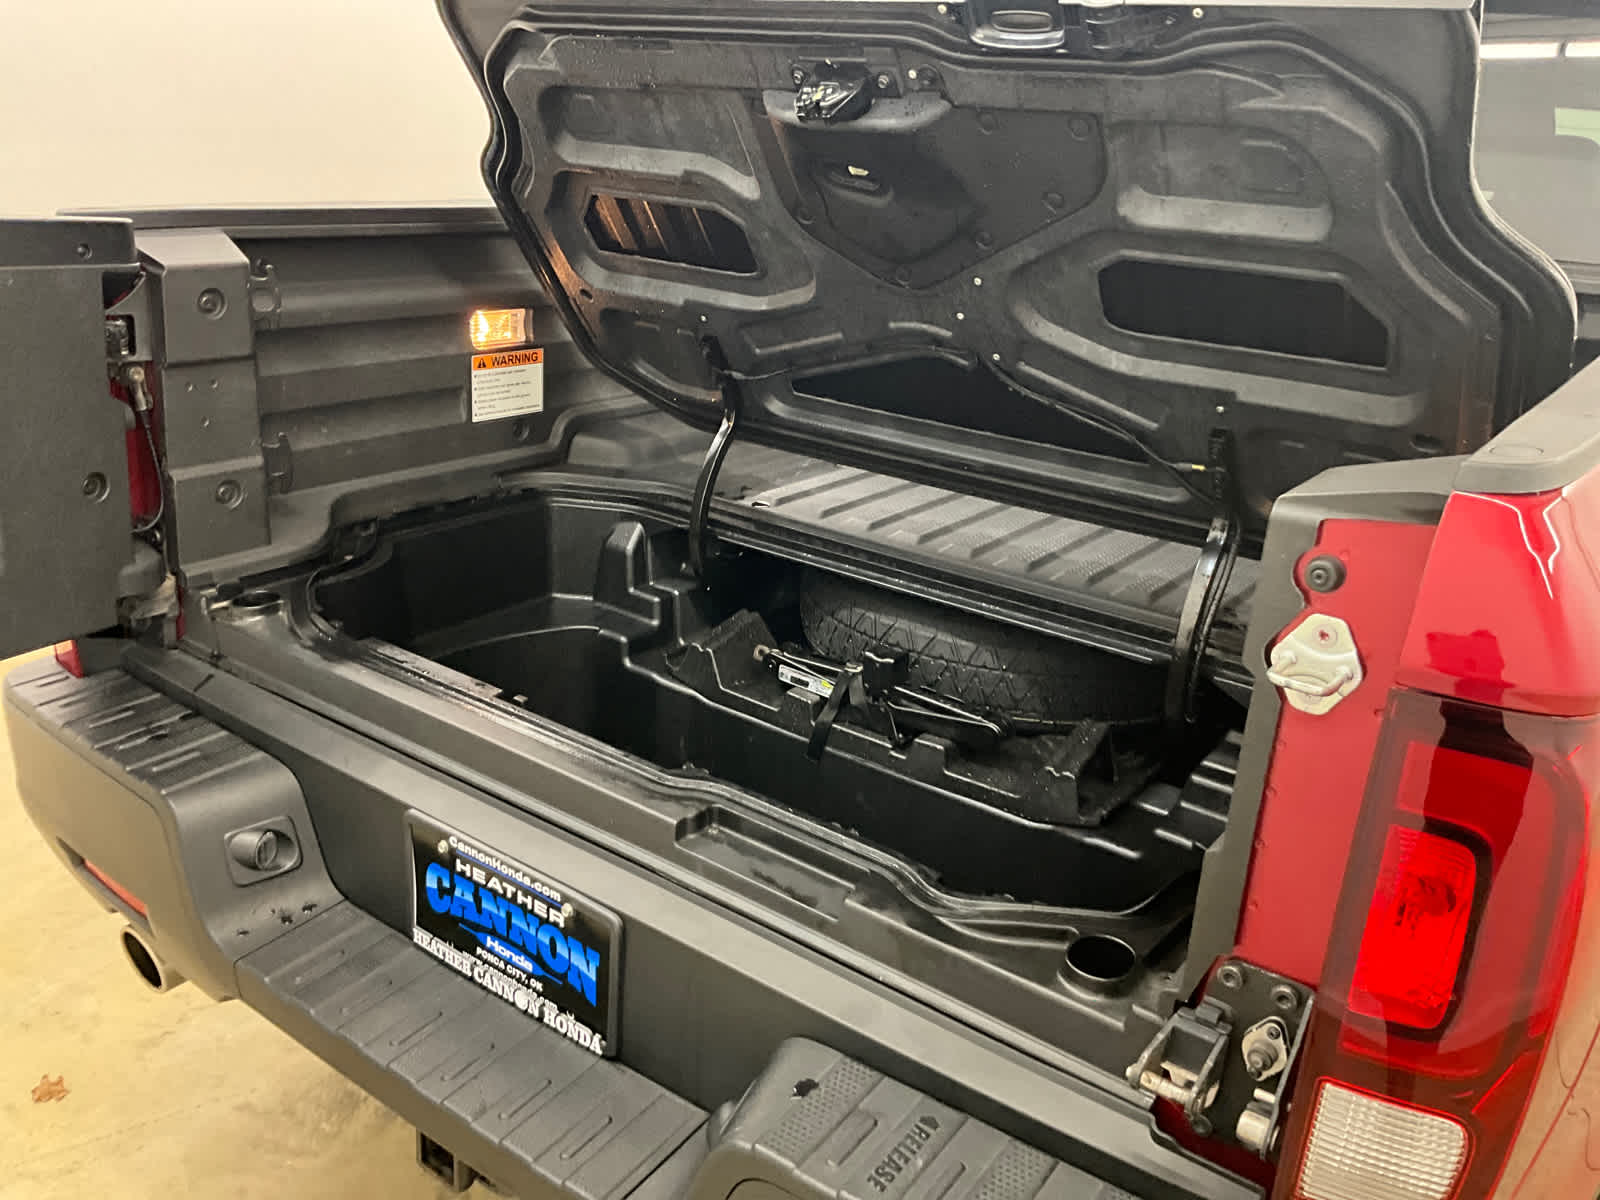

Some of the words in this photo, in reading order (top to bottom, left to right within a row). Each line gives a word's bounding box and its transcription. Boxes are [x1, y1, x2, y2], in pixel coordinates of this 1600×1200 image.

[491, 352, 539, 367] WARNING
[448, 835, 562, 901] CannonHonda.com
[455, 858, 566, 928] HEATHER
[425, 862, 601, 1007] CANNON
[485, 935, 533, 973] Honda
[412, 928, 473, 977] HEATHER
[543, 1008, 604, 1056] HONDA
[476, 946, 505, 970] PONCA
[529, 977, 544, 993] OK
[866, 1122, 931, 1193] RELEASE
